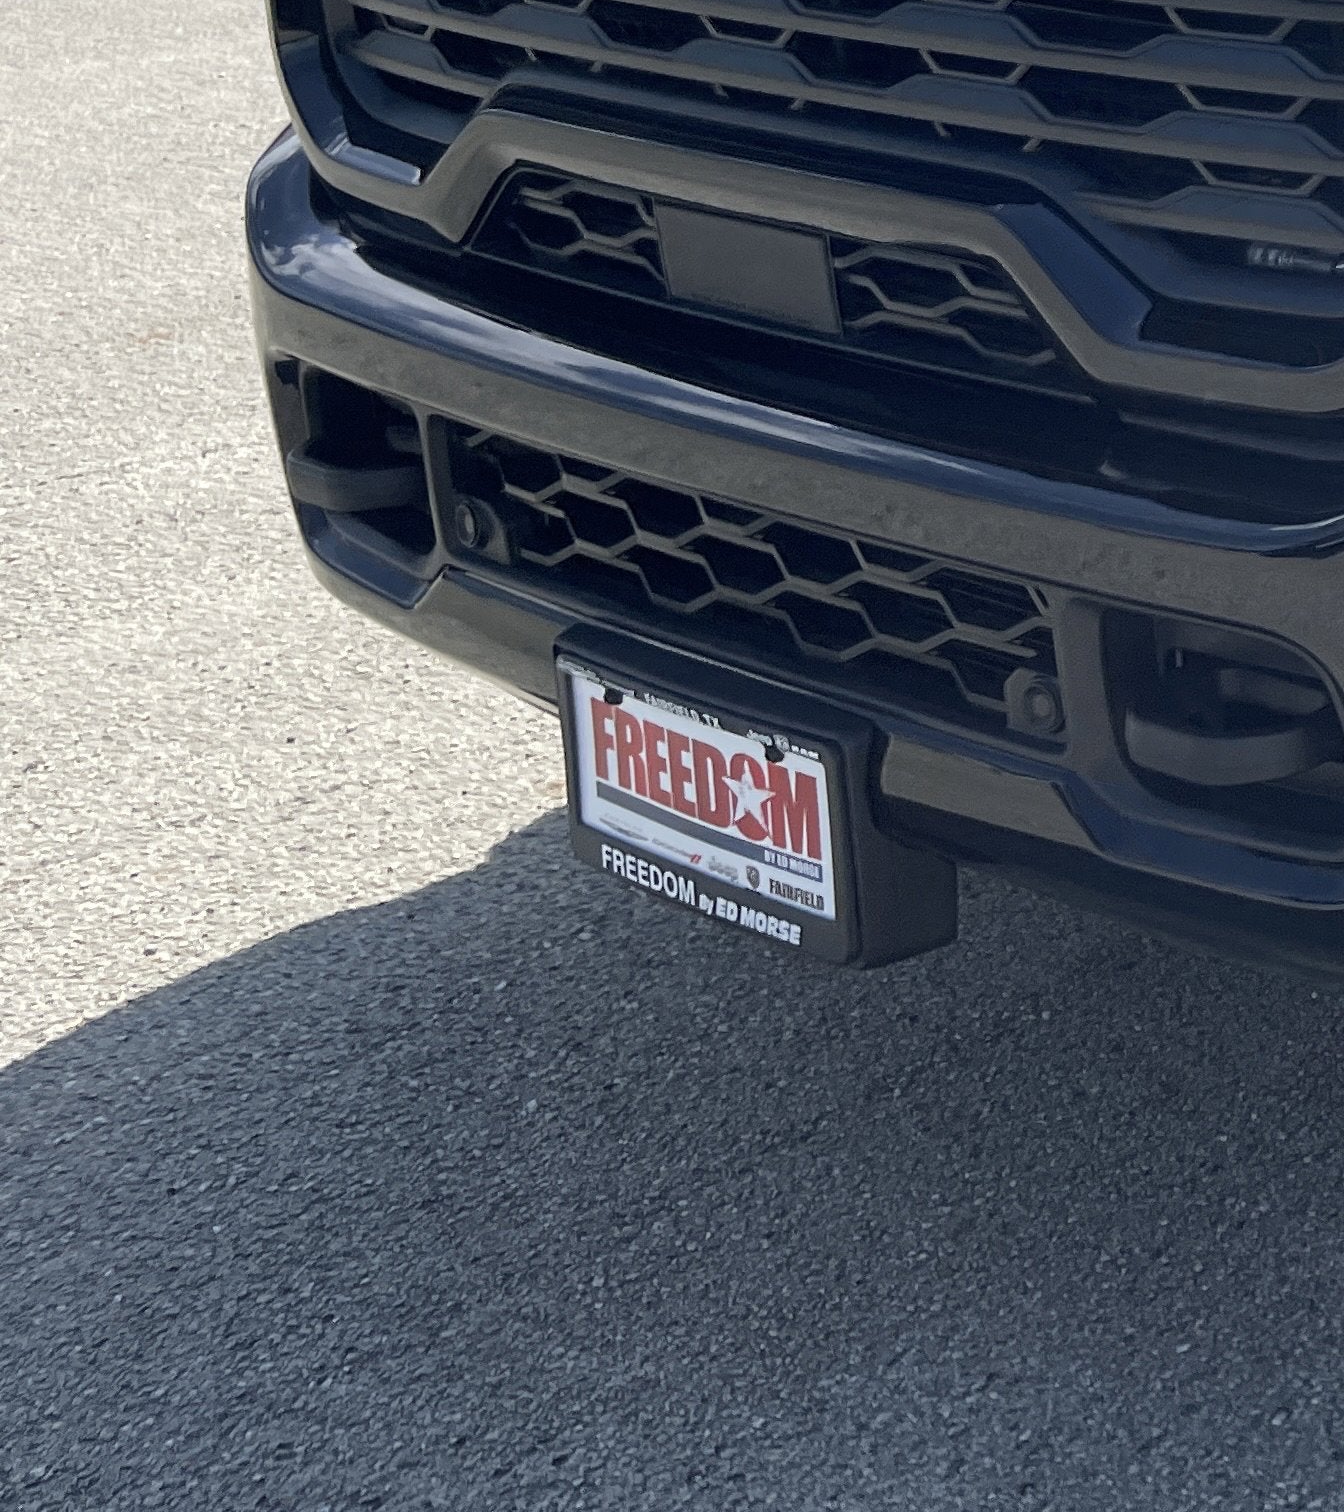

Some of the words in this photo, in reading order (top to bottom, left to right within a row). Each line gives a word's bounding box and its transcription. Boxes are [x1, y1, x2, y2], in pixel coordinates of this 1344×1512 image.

[590, 697, 823, 860] FREEDOM
[601, 843, 696, 906] FREEDOM
[699, 893, 714, 916] by
[716, 896, 738, 922] ED
[740, 904, 803, 946] MORSE
